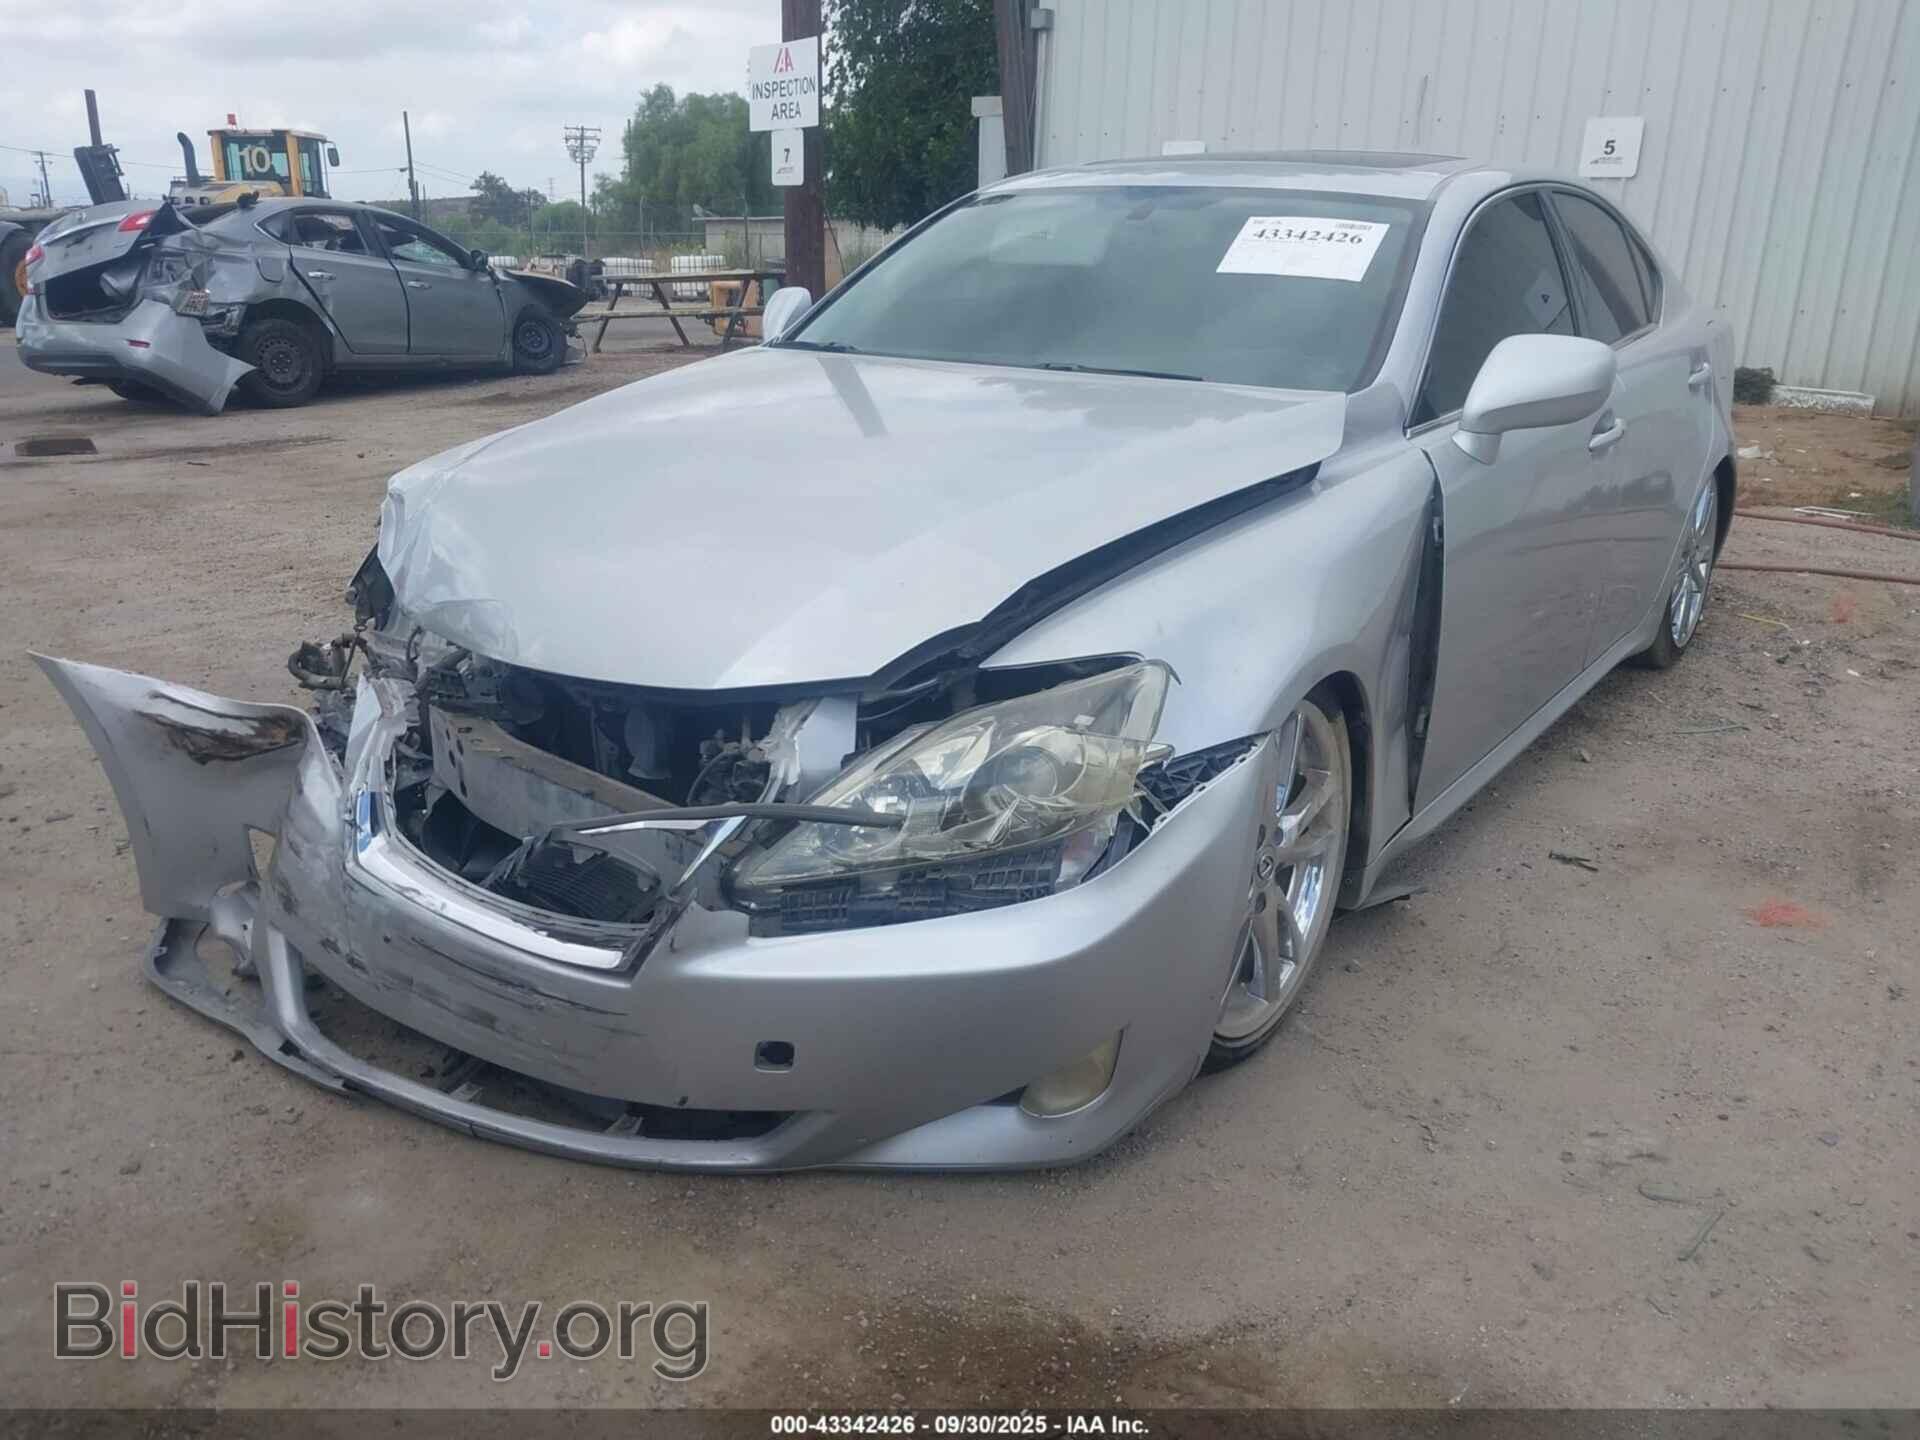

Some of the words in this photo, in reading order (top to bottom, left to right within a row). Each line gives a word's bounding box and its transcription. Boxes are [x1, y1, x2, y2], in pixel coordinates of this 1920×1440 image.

[752, 76, 816, 100] INSPECTION
[771, 101, 801, 121] AREA
[783, 147, 791, 164] 7
[1603, 139, 1616, 156] 5
[240, 145, 271, 173] 10
[1253, 229, 1363, 244] 43342426
